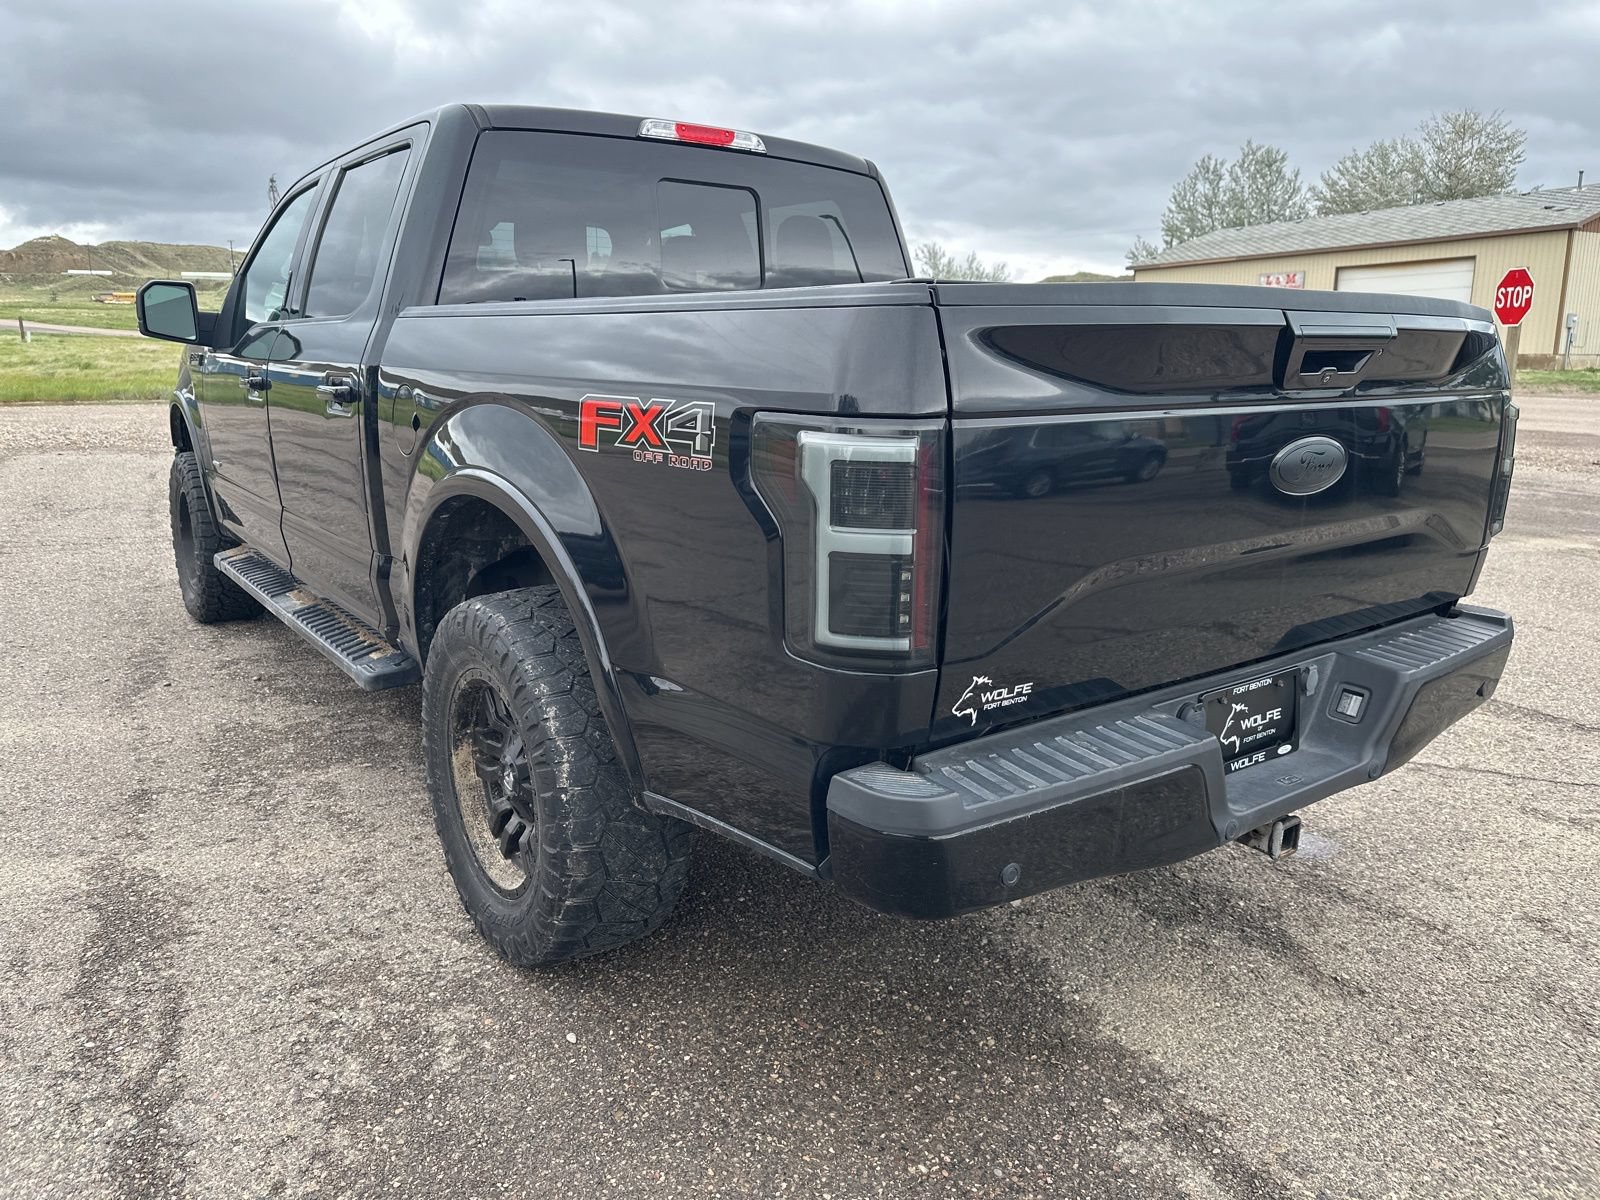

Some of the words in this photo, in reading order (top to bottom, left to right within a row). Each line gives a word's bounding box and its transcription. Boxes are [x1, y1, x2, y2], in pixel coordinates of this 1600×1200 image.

[1496, 285, 1532, 309] STOP
[578, 393, 716, 459] FX4
[632, 449, 663, 464] OFF
[668, 454, 713, 472] ROAD
[1300, 450, 1335, 475] Ford
[981, 682, 1034, 703] WOLFE
[1233, 685, 1249, 695] FORT
[1249, 678, 1273, 691] BENTON
[983, 702, 1001, 710] FORT
[1001, 696, 1028, 707] BENTON
[1240, 707, 1282, 731] WOLFE
[1243, 734, 1257, 743] FORT
[1256, 728, 1276, 739] BENTON
[1230, 752, 1266, 771] WOLFE
